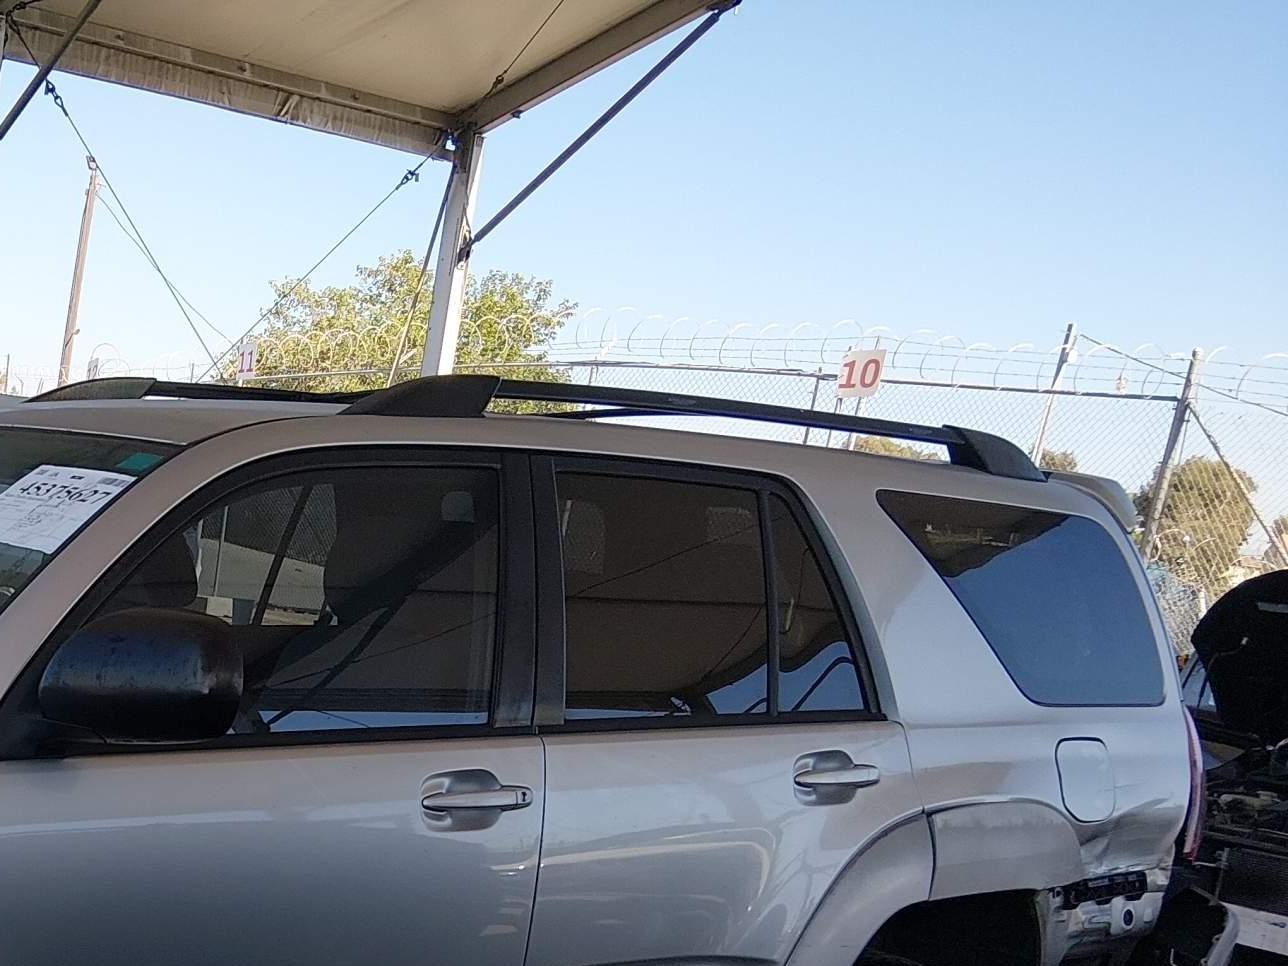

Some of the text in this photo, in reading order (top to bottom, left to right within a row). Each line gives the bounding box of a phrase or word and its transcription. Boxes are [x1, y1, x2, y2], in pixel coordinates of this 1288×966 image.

[238, 350, 254, 373] 11
[838, 358, 881, 388] 10
[19, 481, 111, 504] 45375627
